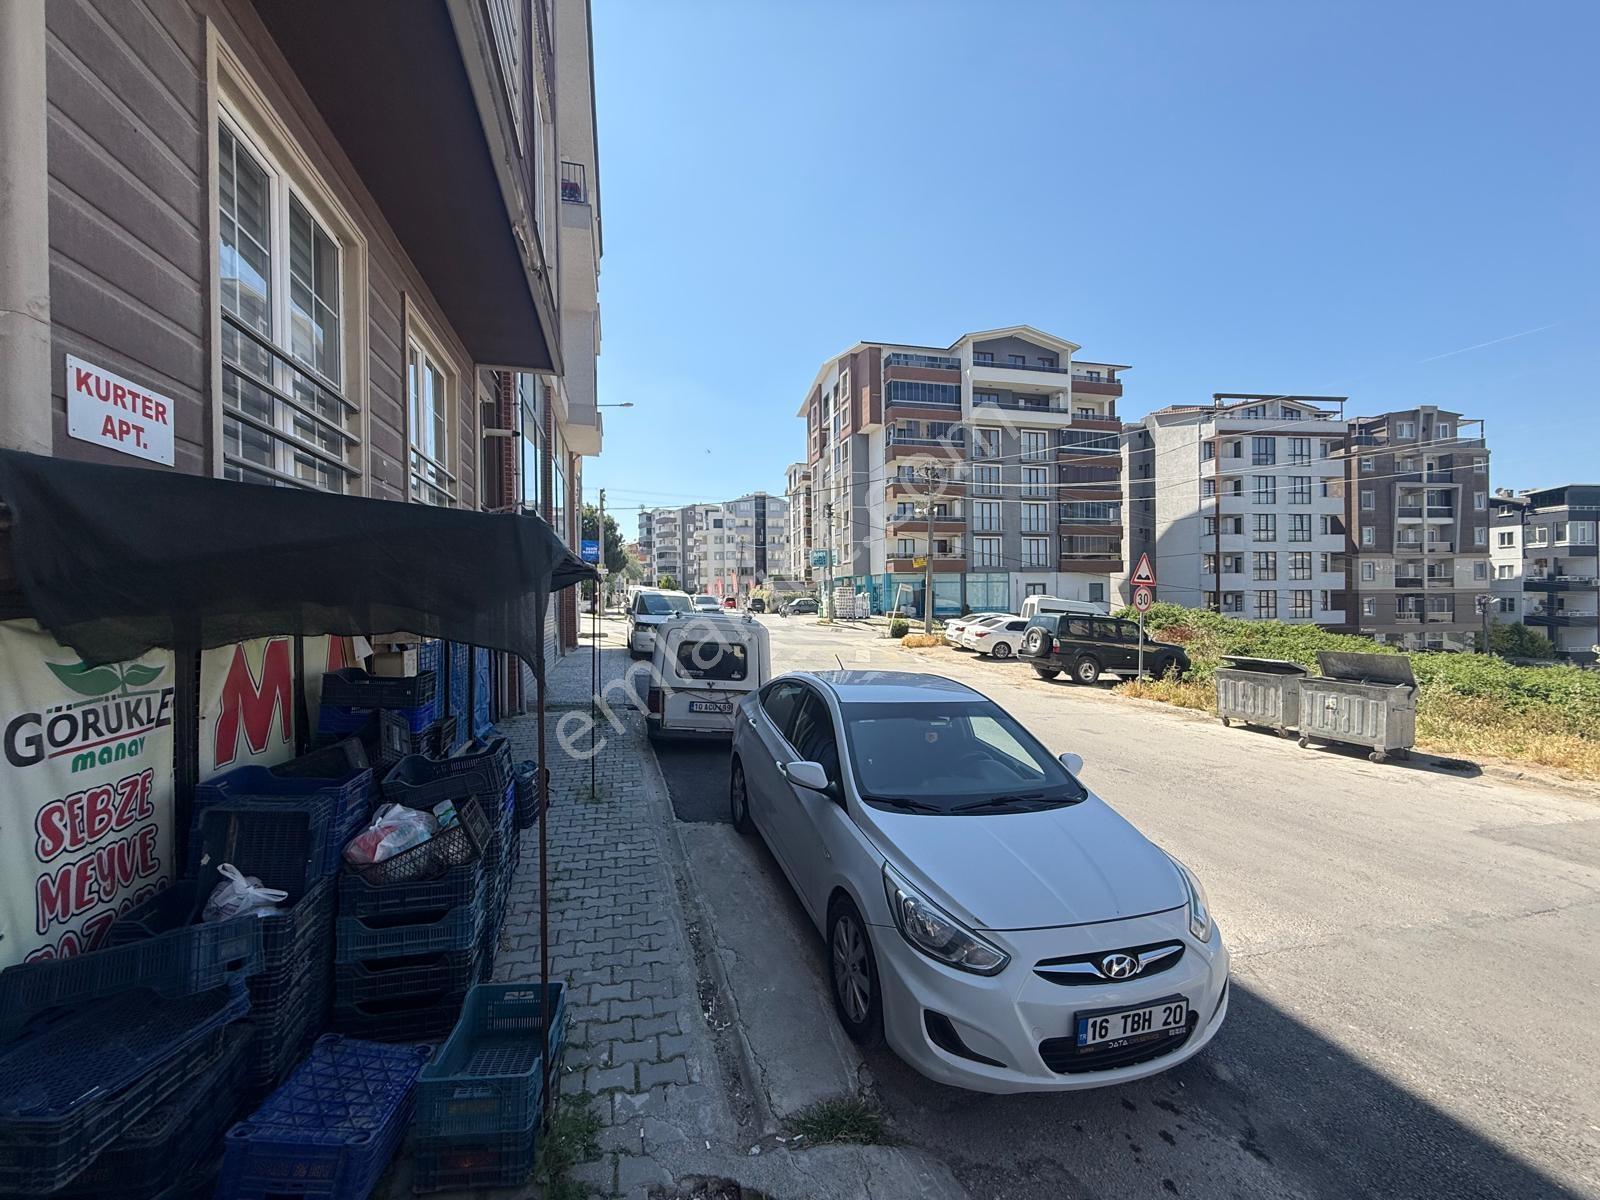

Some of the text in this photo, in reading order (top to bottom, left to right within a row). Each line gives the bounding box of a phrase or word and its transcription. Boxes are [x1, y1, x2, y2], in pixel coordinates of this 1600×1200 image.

[75, 367, 168, 425] KURTER
[101, 415, 148, 449] APT.
[1137, 593, 1149, 606] 30
[4, 687, 175, 768] GÖRÜKLE
[35, 769, 155, 862] SEBZE
[36, 824, 160, 935] MEYVE
[1090, 1018, 1110, 1041] 16
[1120, 1010, 1153, 1035] TBH
[1162, 1004, 1184, 1028] 20
